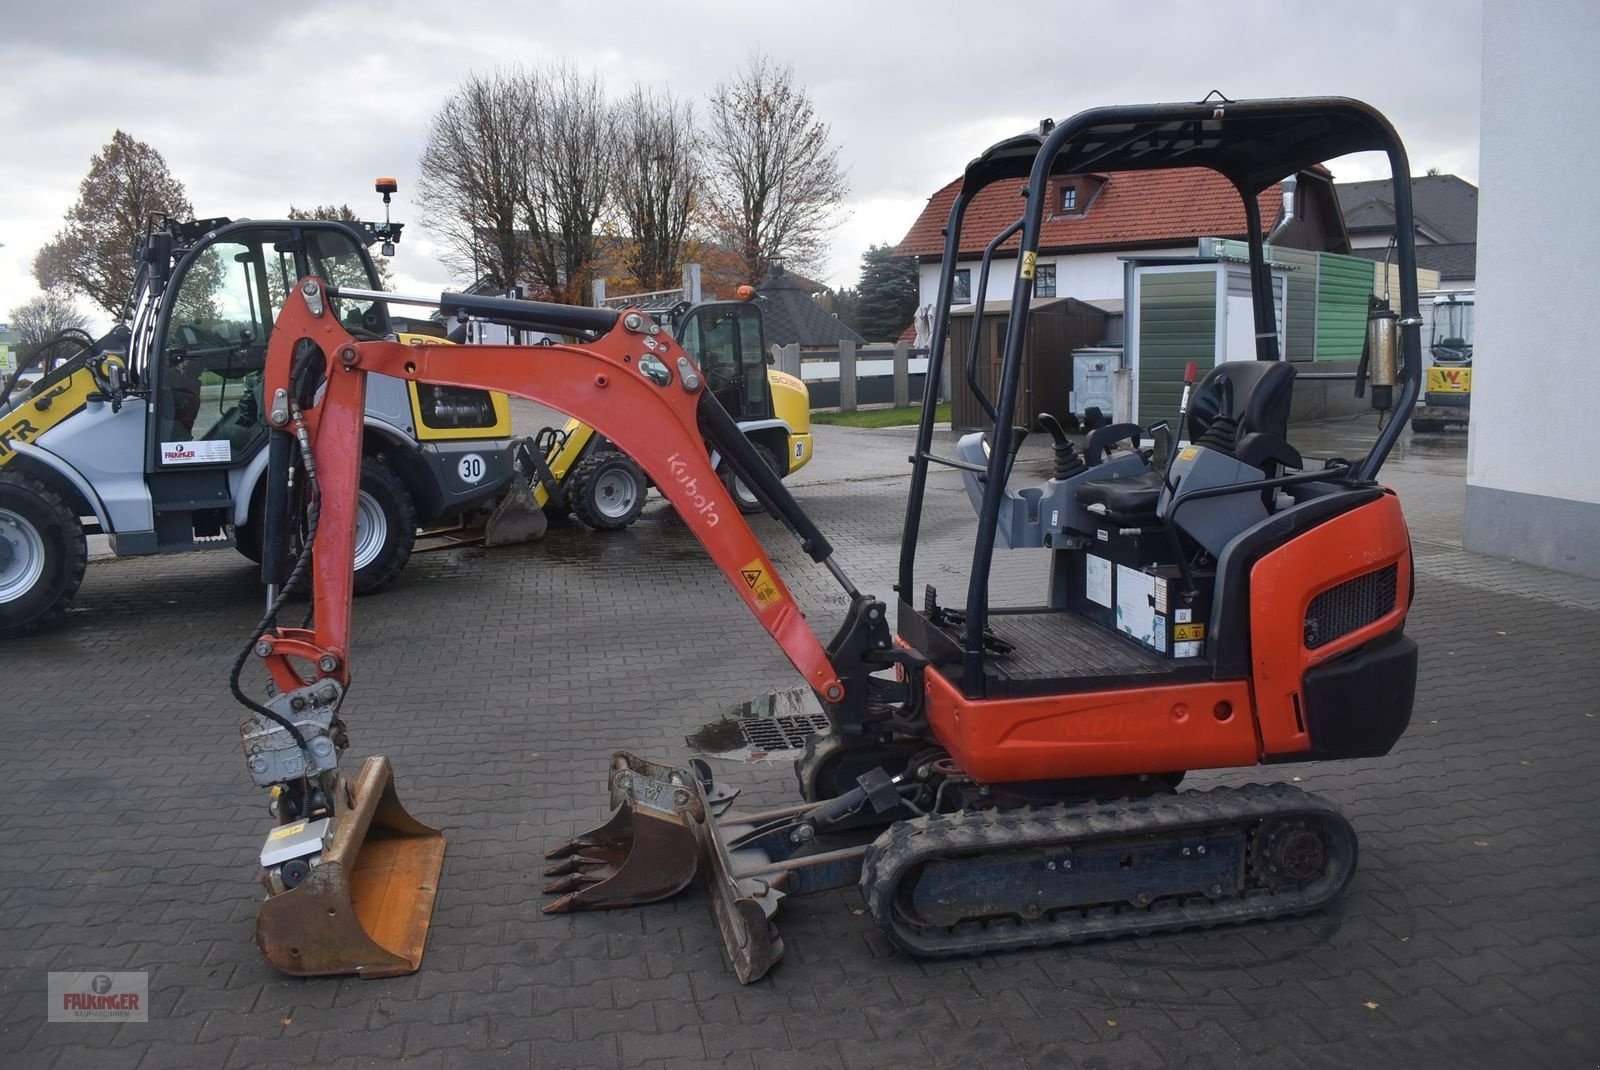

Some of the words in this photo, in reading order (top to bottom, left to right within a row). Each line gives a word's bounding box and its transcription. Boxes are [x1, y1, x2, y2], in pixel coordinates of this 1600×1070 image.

[796, 443, 803, 457] 20
[463, 459, 480, 477] 30
[667, 452, 719, 528] Kubota
